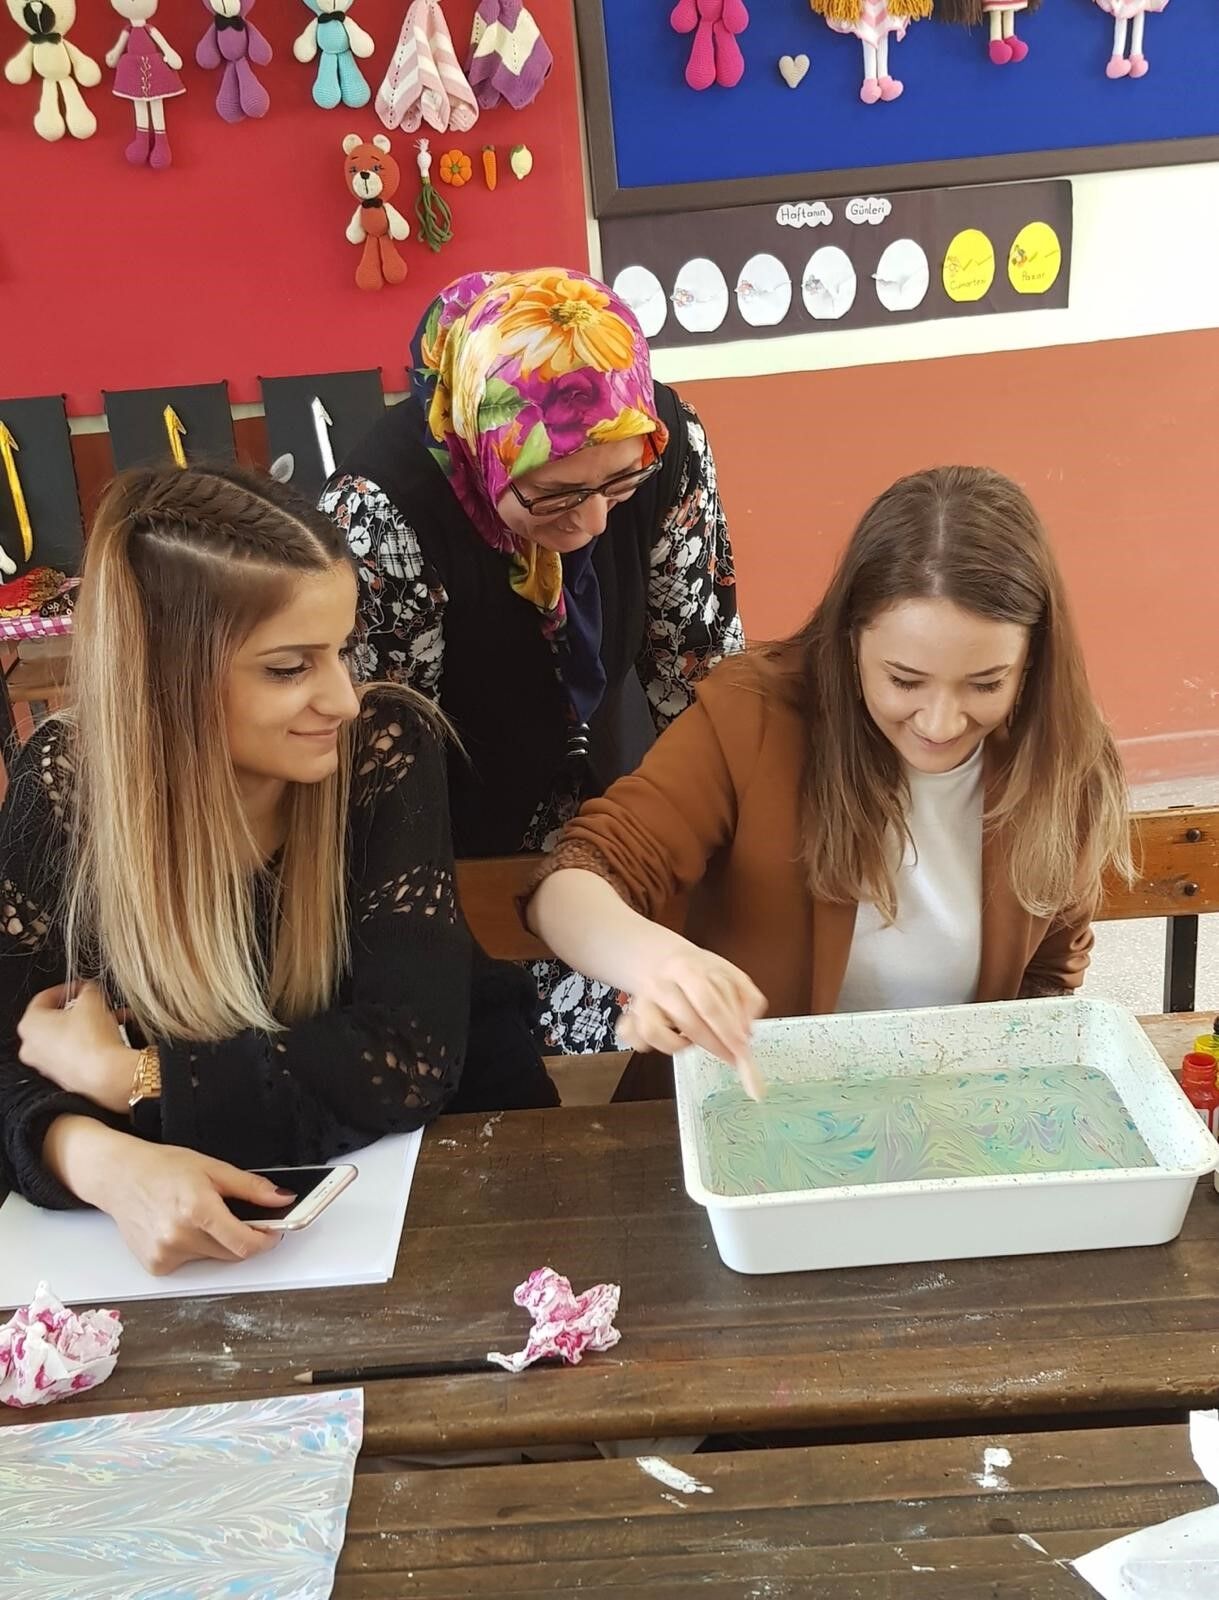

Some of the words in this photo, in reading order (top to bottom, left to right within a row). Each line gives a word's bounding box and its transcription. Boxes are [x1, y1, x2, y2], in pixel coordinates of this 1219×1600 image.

[781, 206, 826, 222] Haftanın
[850, 202, 885, 216] Günleri
[1022, 271, 1046, 282] Pazar
